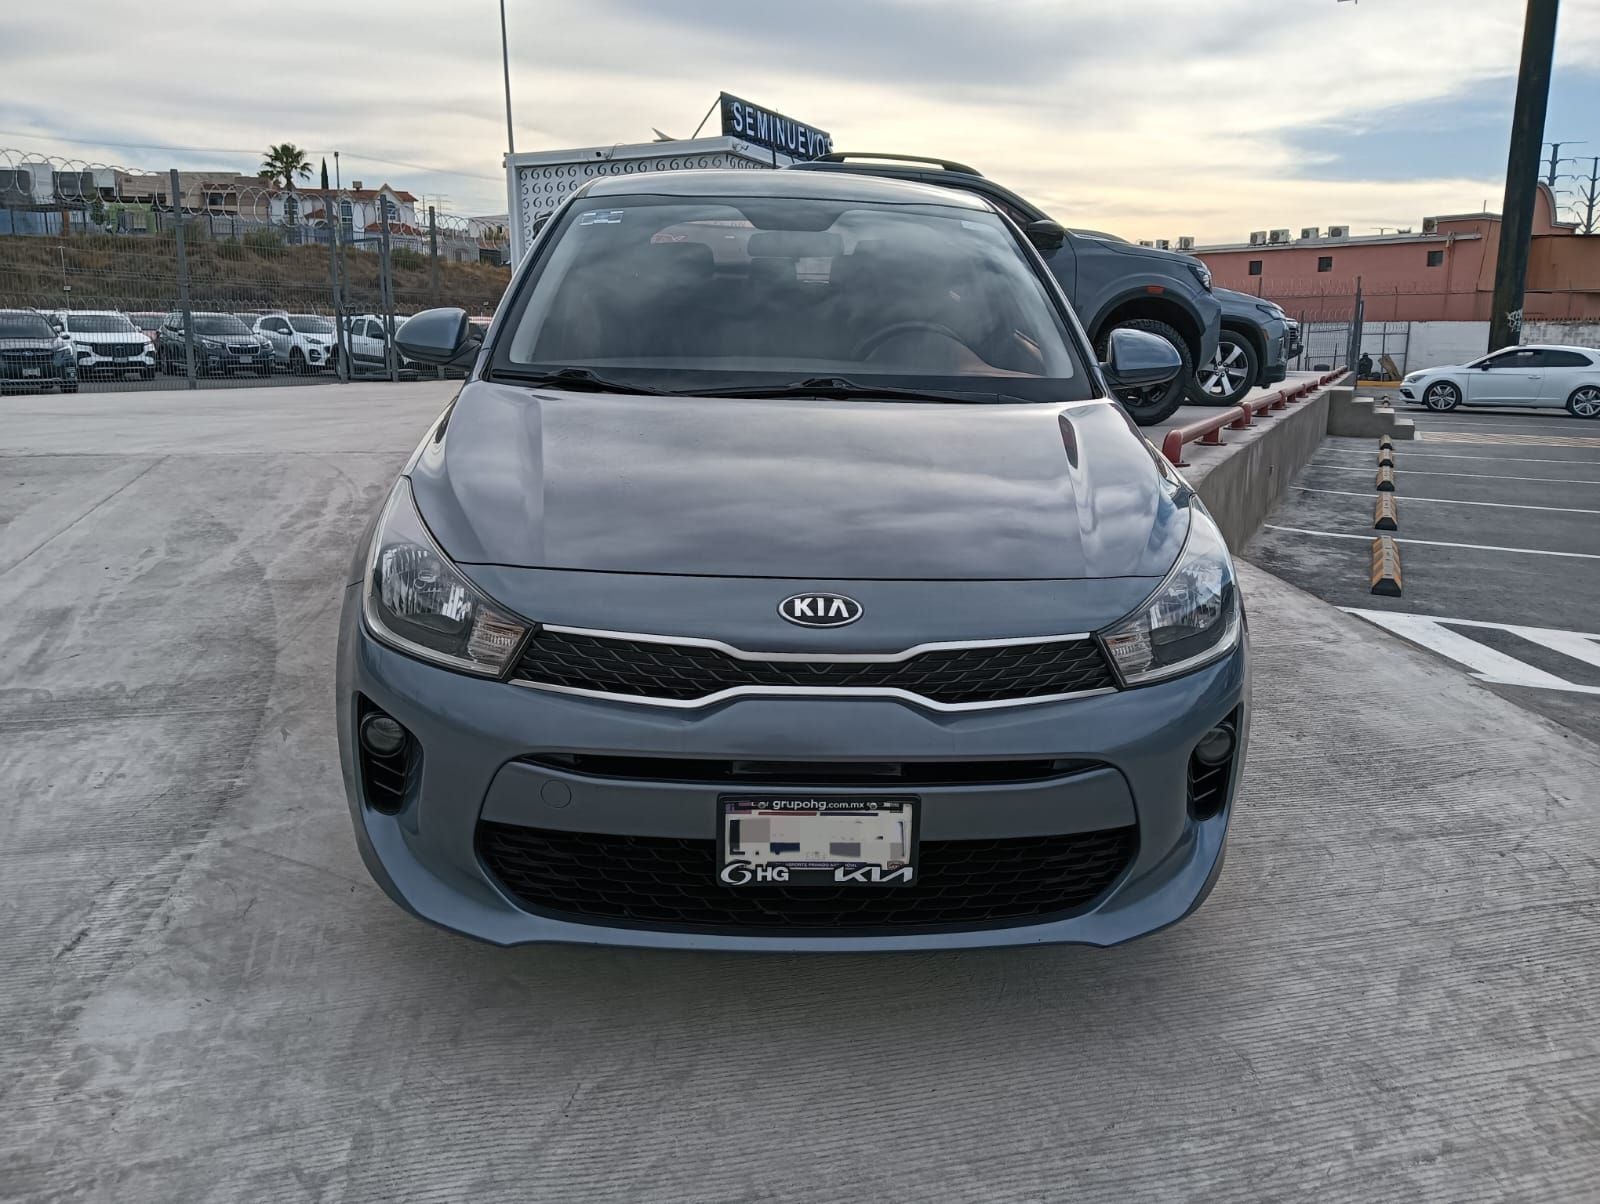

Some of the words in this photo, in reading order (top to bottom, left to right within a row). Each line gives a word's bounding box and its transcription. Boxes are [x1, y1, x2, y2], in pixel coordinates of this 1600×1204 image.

[793, 597, 850, 618] KIA
[772, 799, 865, 811] grupohg.com.mx
[834, 866, 913, 882] KIA
